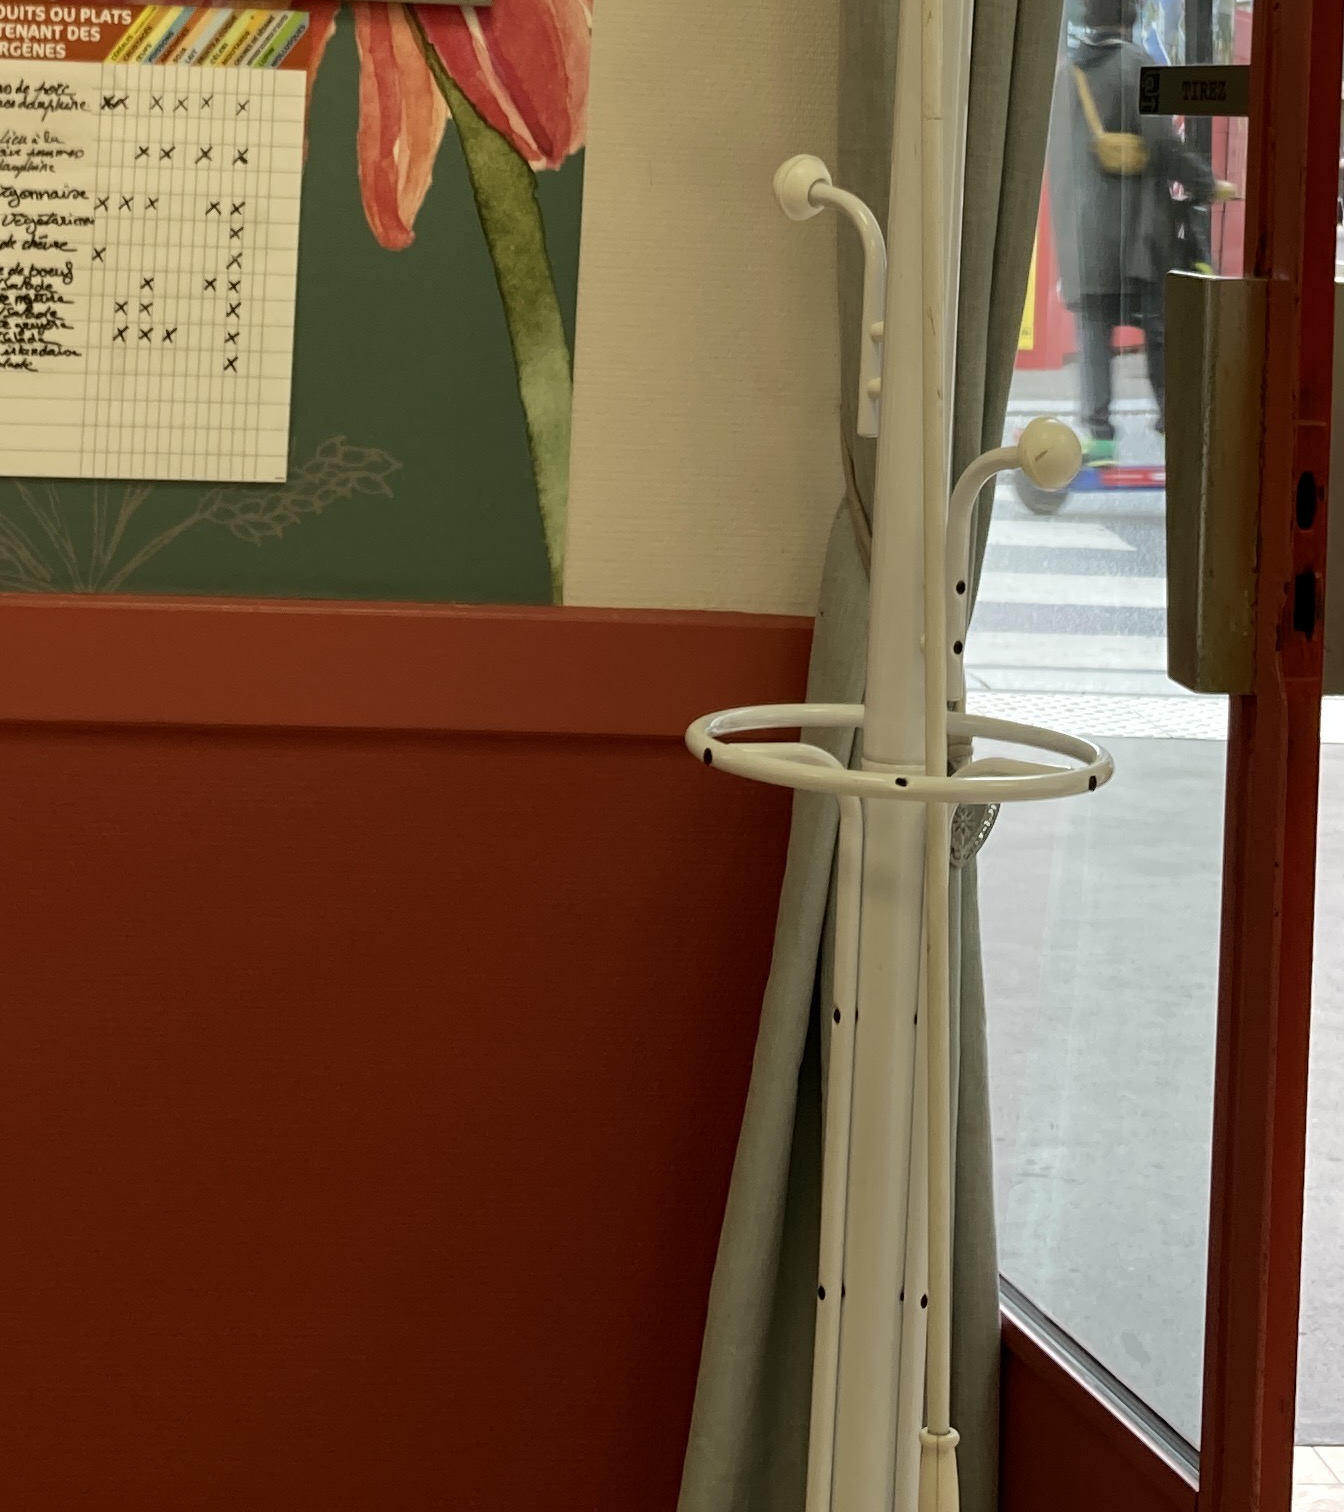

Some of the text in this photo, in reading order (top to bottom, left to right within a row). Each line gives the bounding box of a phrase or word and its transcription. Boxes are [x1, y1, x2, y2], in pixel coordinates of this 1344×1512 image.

[50, 7, 76, 23] OU
[80, 9, 133, 25] PLATS
[67, 26, 101, 42] DES
[1181, 81, 1227, 102] TIREZ
